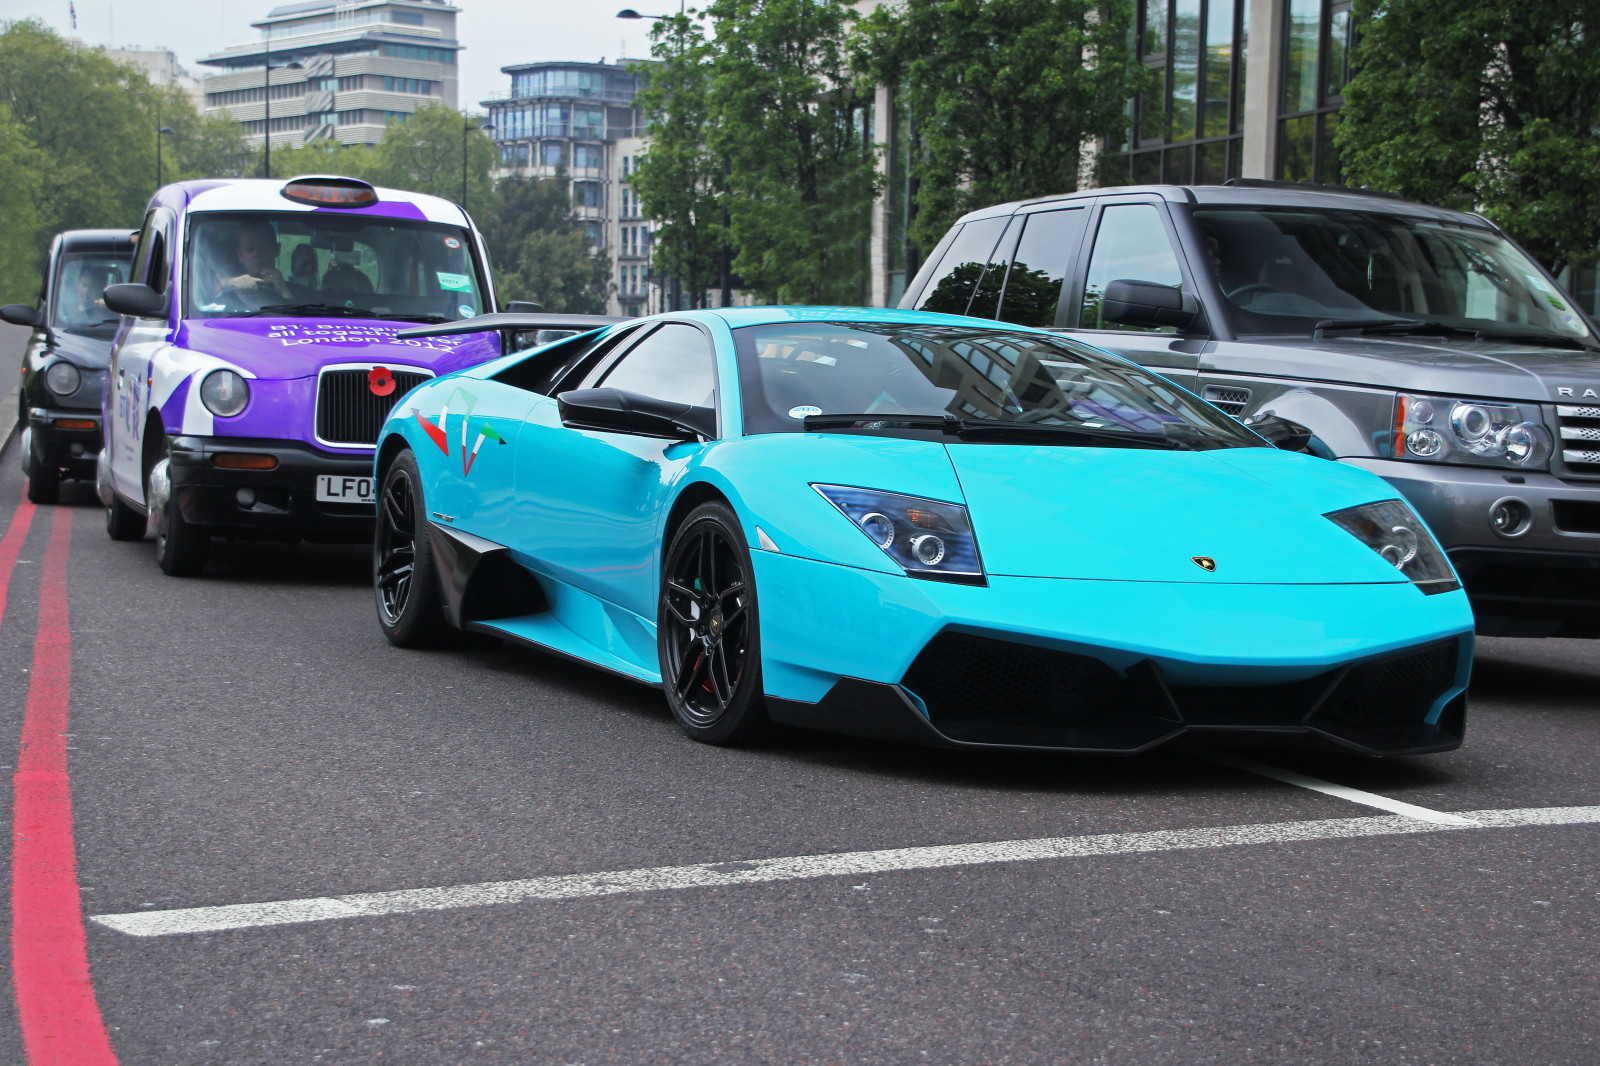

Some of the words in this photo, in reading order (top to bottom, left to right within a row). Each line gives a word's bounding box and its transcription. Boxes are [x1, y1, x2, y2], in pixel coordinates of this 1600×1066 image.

[268, 330, 296, 338] all
[281, 336, 381, 347] London
[387, 337, 456, 355] 2012
[326, 477, 376, 498] LF0
